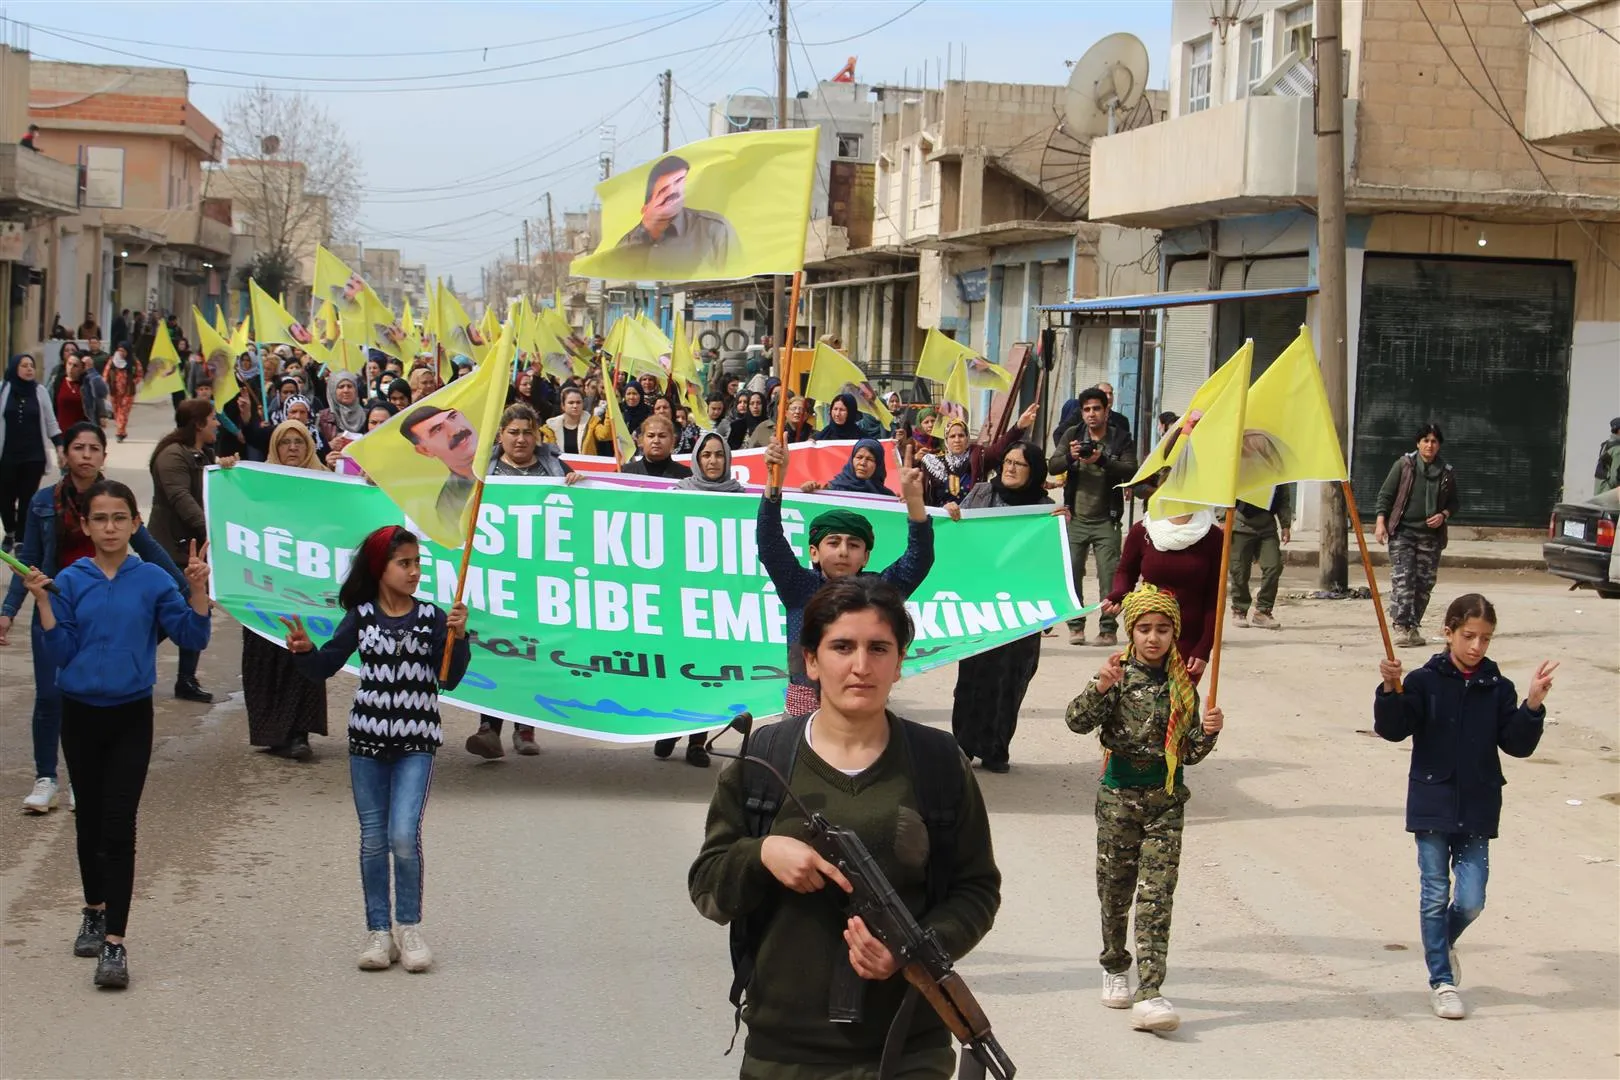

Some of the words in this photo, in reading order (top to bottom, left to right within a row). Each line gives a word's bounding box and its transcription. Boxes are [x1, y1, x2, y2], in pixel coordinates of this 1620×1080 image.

[405, 493, 574, 562] STÊ
[593, 510, 664, 569] KU
[684, 507, 814, 577] DIRÊ
[680, 581, 788, 644] EMÊ
[904, 591, 1057, 641] KÎNİN
[550, 650, 667, 679] التي
